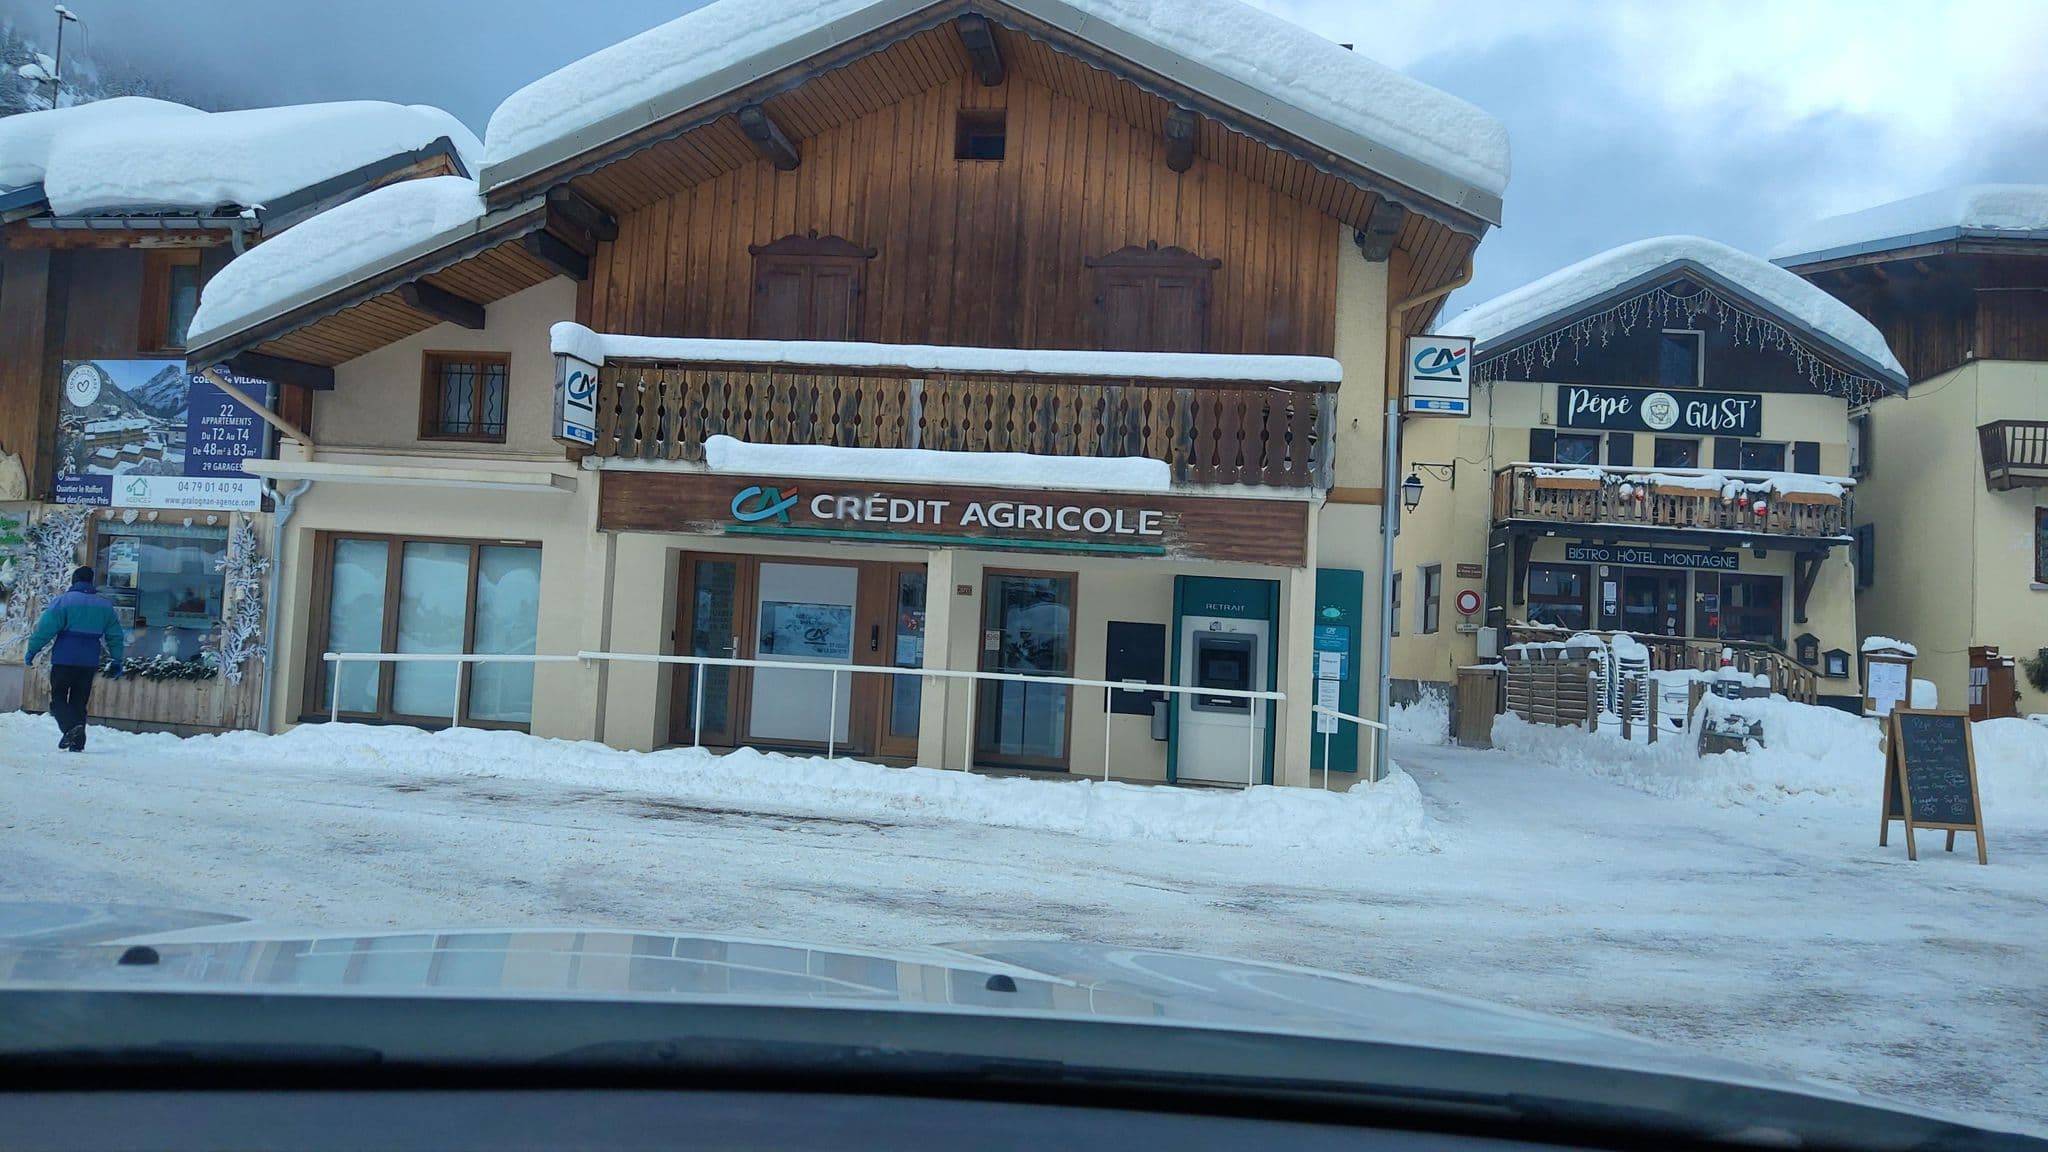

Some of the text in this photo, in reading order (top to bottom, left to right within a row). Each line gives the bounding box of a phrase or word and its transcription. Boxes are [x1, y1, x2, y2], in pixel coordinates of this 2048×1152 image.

[220, 404, 234, 417] 22
[1568, 388, 1634, 426] Pépé
[201, 416, 252, 426] APPARTEMENTS
[213, 428, 225, 440] T2
[237, 429, 250, 441] T4
[192, 447, 202, 456] De
[202, 462, 243, 472] 29 GARAGES
[178, 481, 243, 493] 04 79 01 40 94
[810, 492, 950, 525] CRÉDIT
[959, 502, 1165, 537] AGRICOLE
[1568, 548, 1737, 569] BISTRO HÔTEL MONTAGNE
[1205, 603, 1246, 612] RETRAIT
